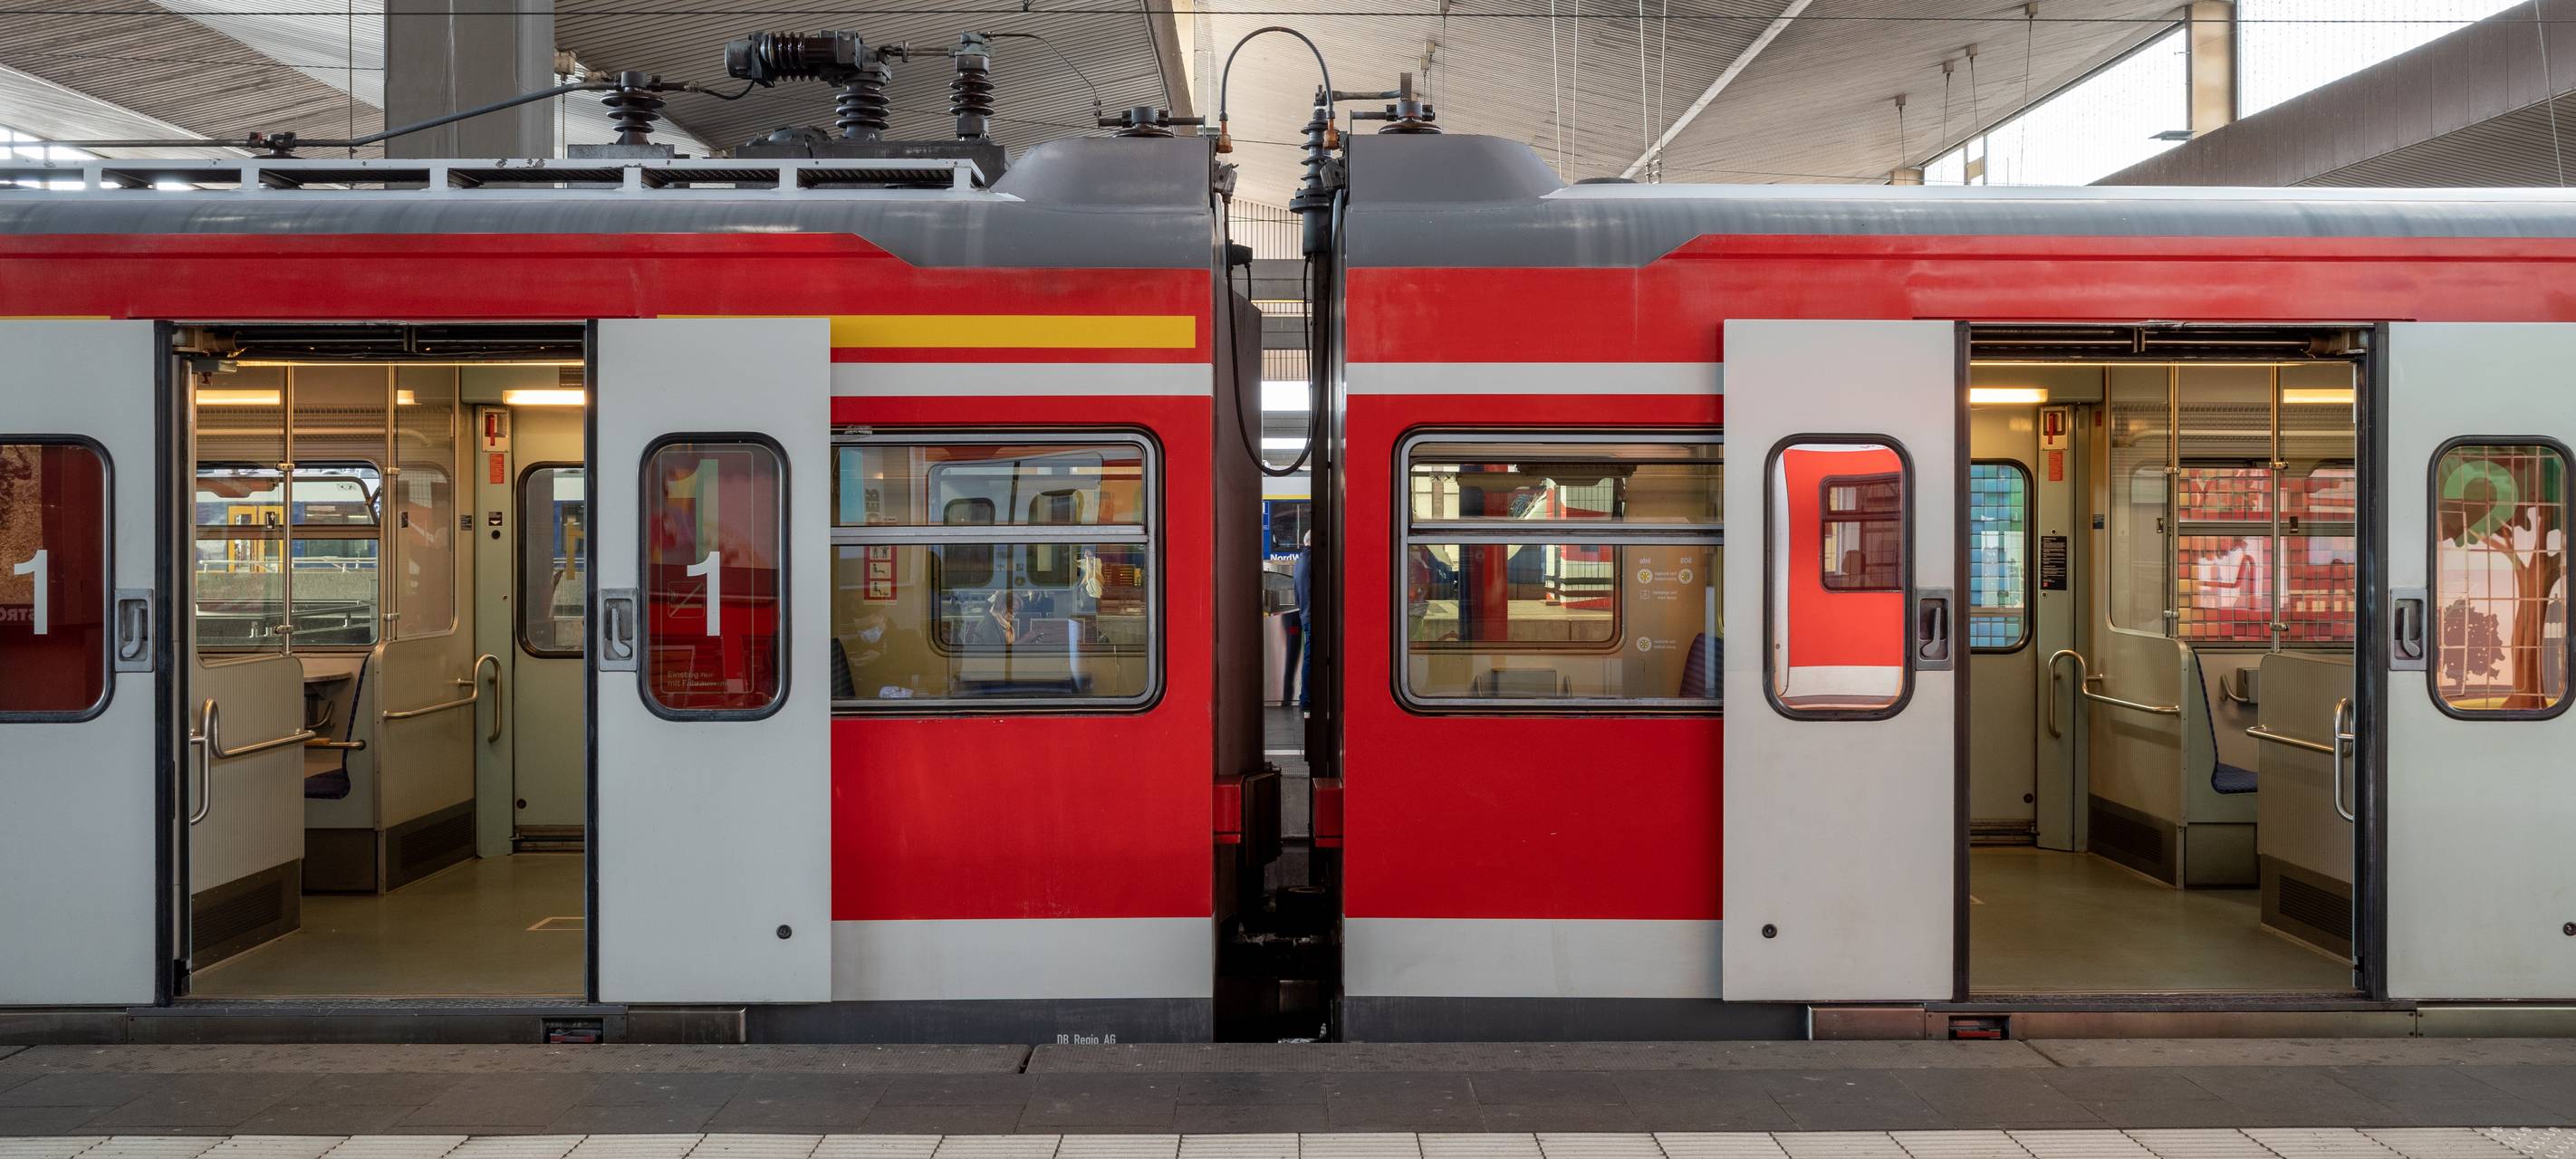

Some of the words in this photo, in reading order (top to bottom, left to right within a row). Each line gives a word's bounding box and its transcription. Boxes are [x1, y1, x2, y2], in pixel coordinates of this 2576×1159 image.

[14, 549, 48, 635] 1
[687, 551, 721, 637] 1
[1057, 1034, 1069, 1044] DB
[1073, 1033, 1100, 1044] Regio
[1103, 1034, 1117, 1044] AG
